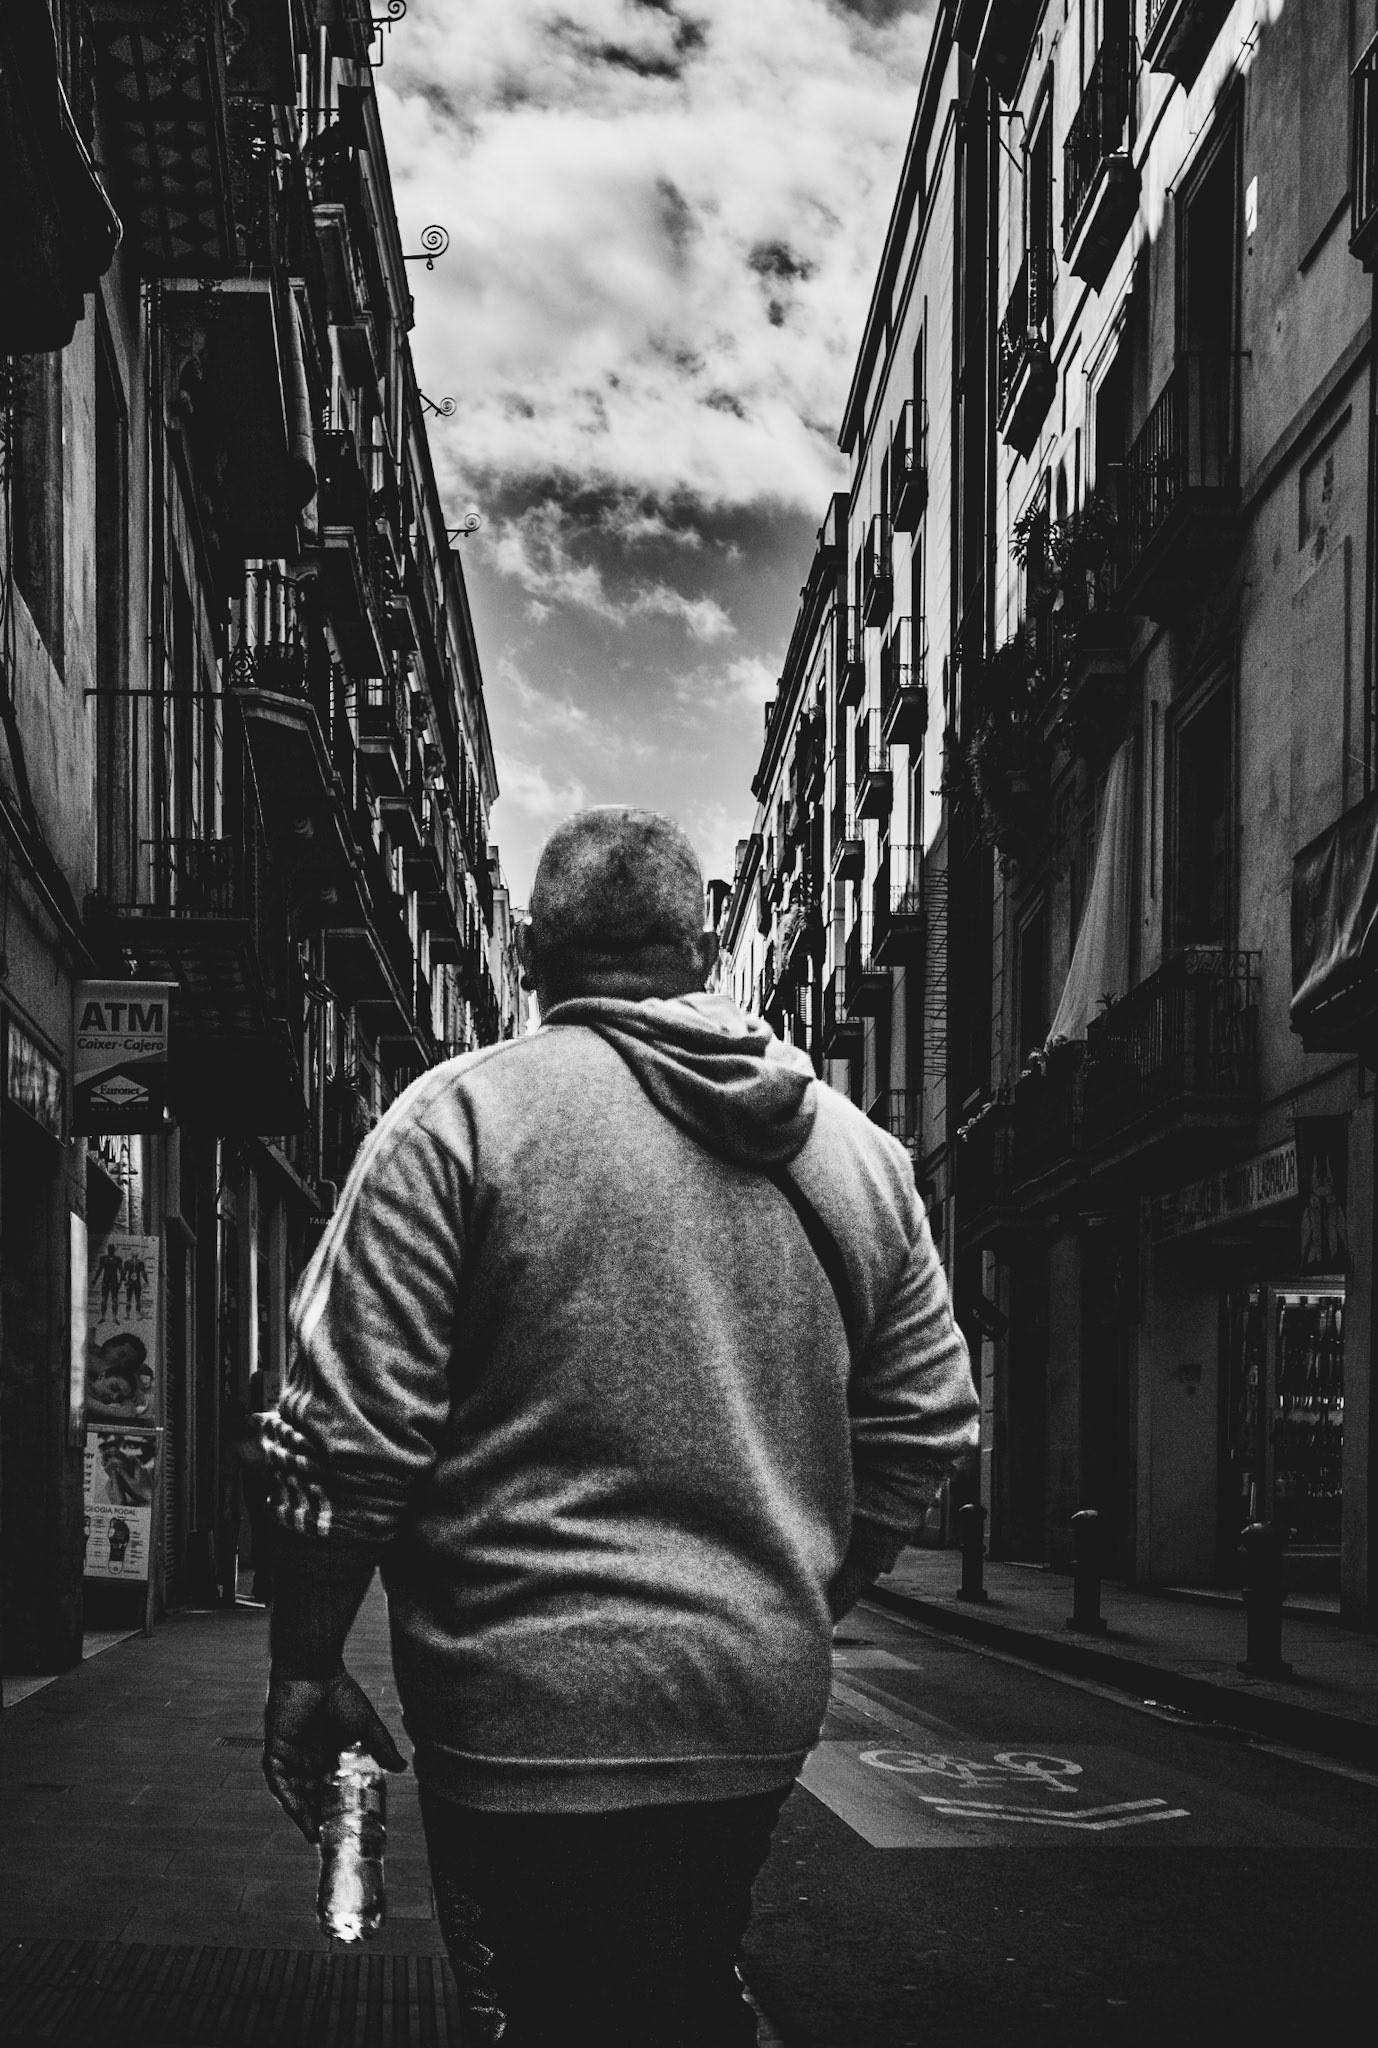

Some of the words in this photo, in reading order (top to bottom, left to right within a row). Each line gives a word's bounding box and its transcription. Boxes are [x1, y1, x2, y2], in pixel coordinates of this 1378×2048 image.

[79, 1002, 163, 1033] ATM
[77, 1038, 117, 1050] Caixer
[124, 1039, 164, 1053] Cajero
[100, 1085, 140, 1095] Euronet
